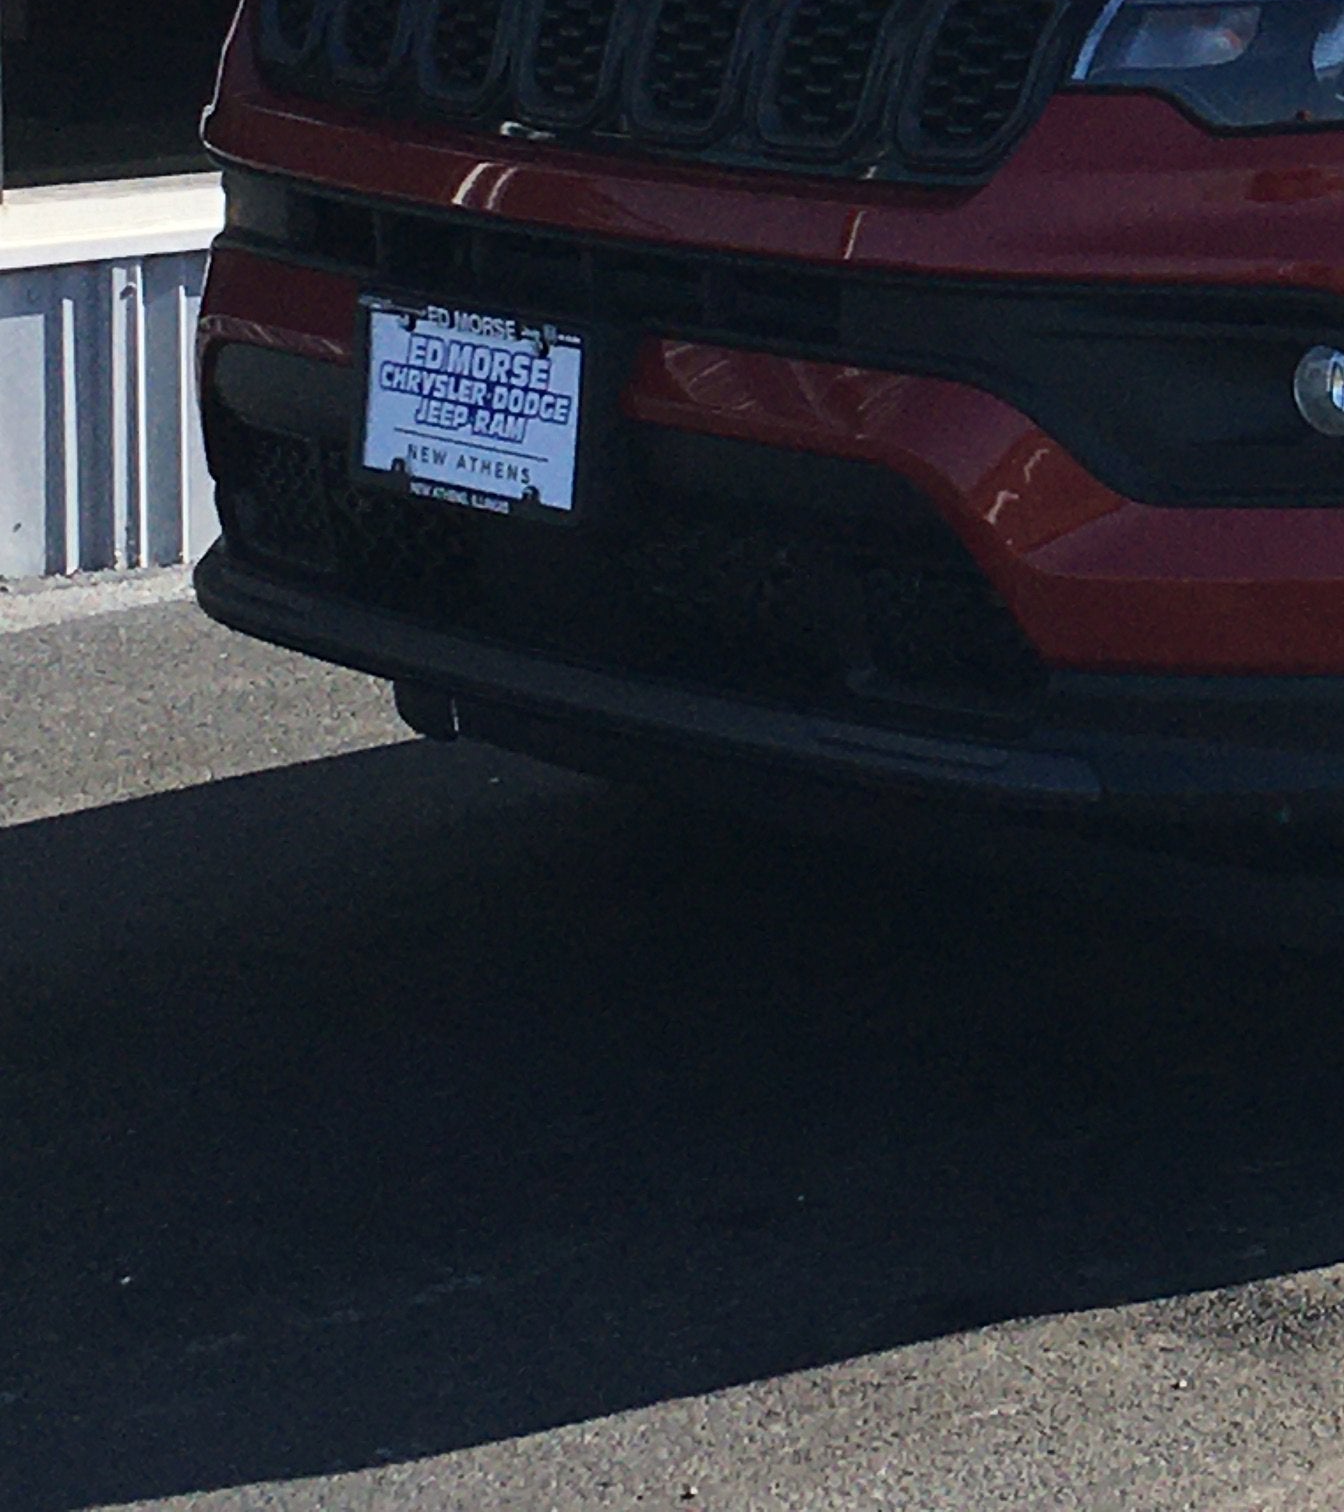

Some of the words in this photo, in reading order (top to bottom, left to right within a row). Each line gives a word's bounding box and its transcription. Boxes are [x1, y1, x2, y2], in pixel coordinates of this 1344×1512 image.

[426, 305, 450, 328] ED
[454, 310, 517, 340] MORSE
[408, 332, 447, 371] ED
[447, 339, 551, 392] MORSE
[407, 443, 449, 467] NEW
[456, 454, 532, 485] ATHENS
